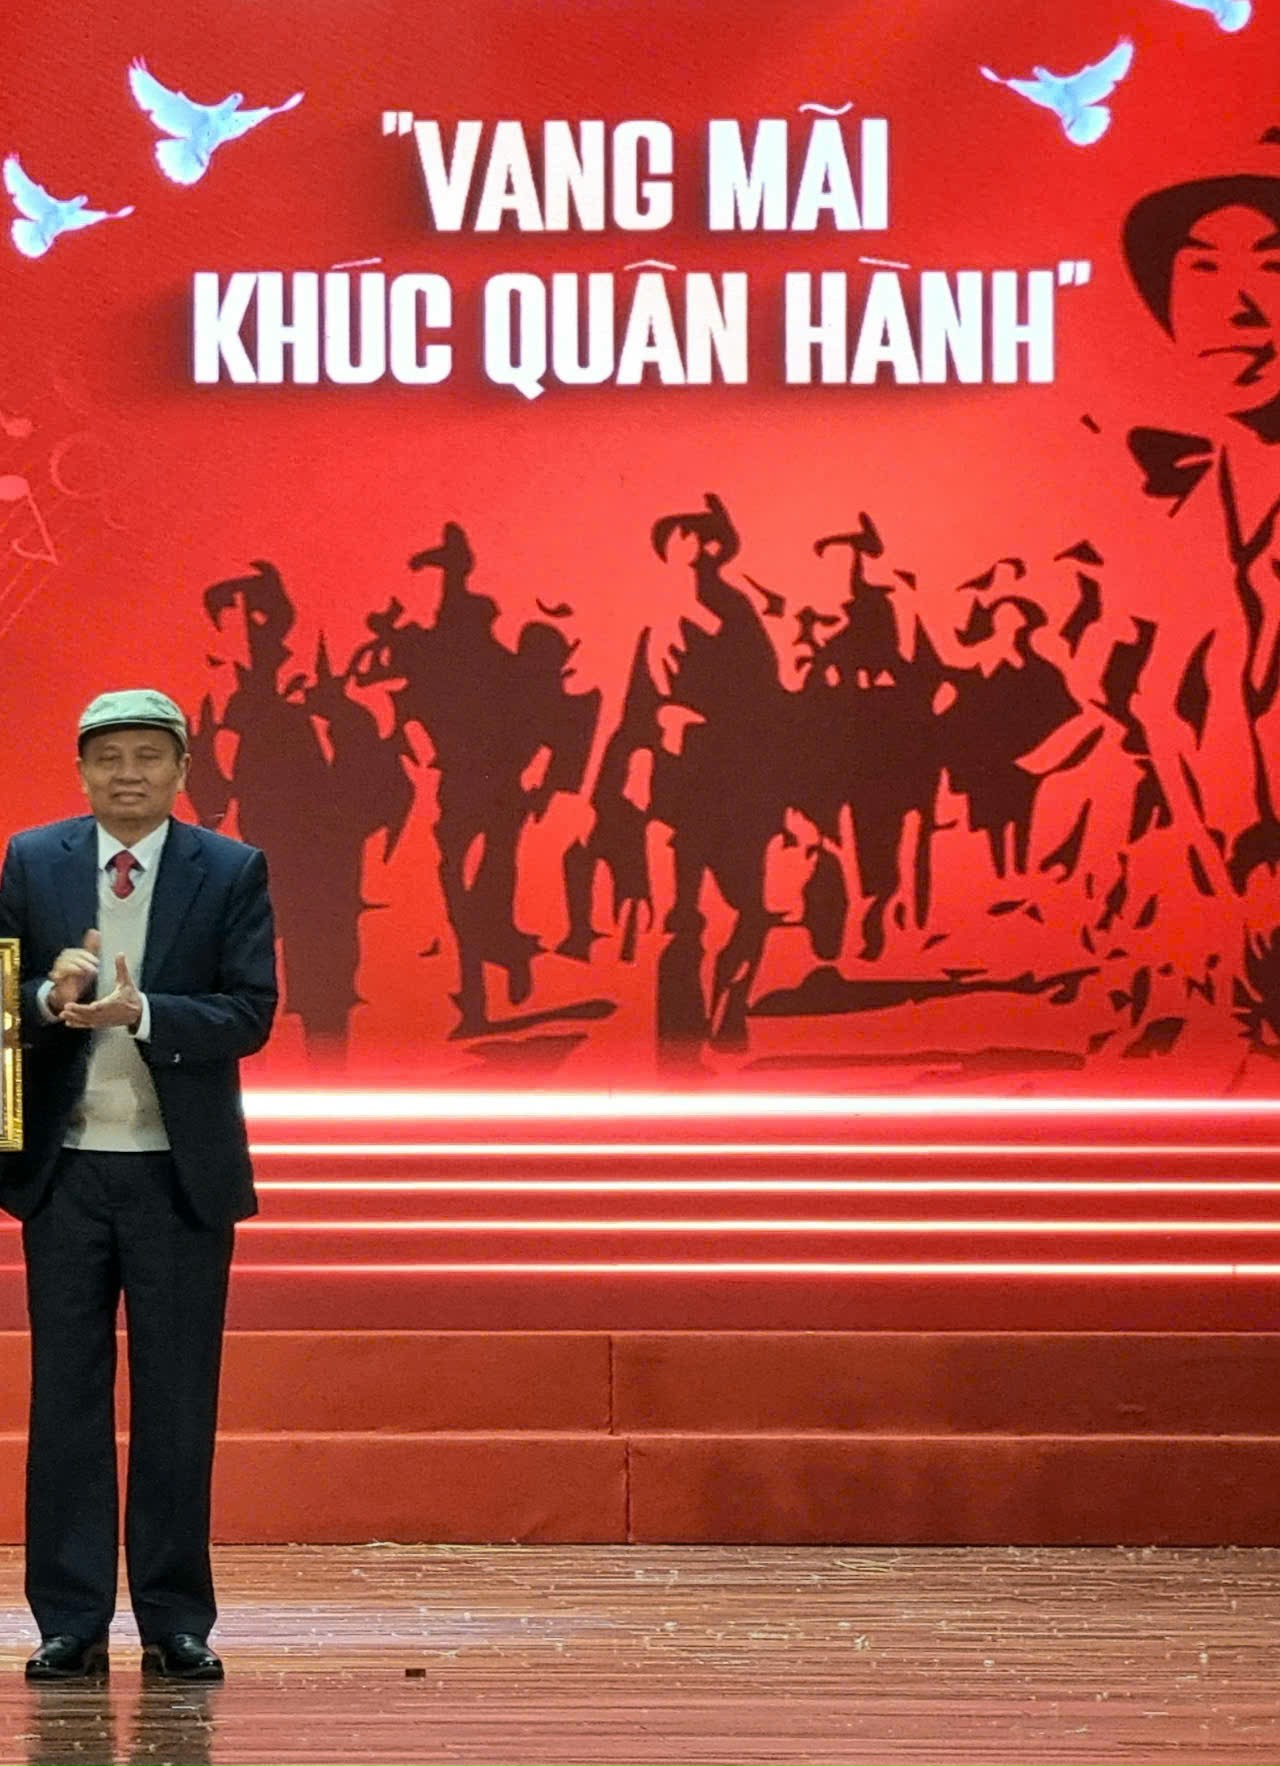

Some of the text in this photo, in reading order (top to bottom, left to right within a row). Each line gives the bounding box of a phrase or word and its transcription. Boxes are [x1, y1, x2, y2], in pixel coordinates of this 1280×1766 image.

[709, 102, 890, 232] MÃI
[194, 258, 454, 386] KHÚC
[484, 260, 750, 400] QUÂN
